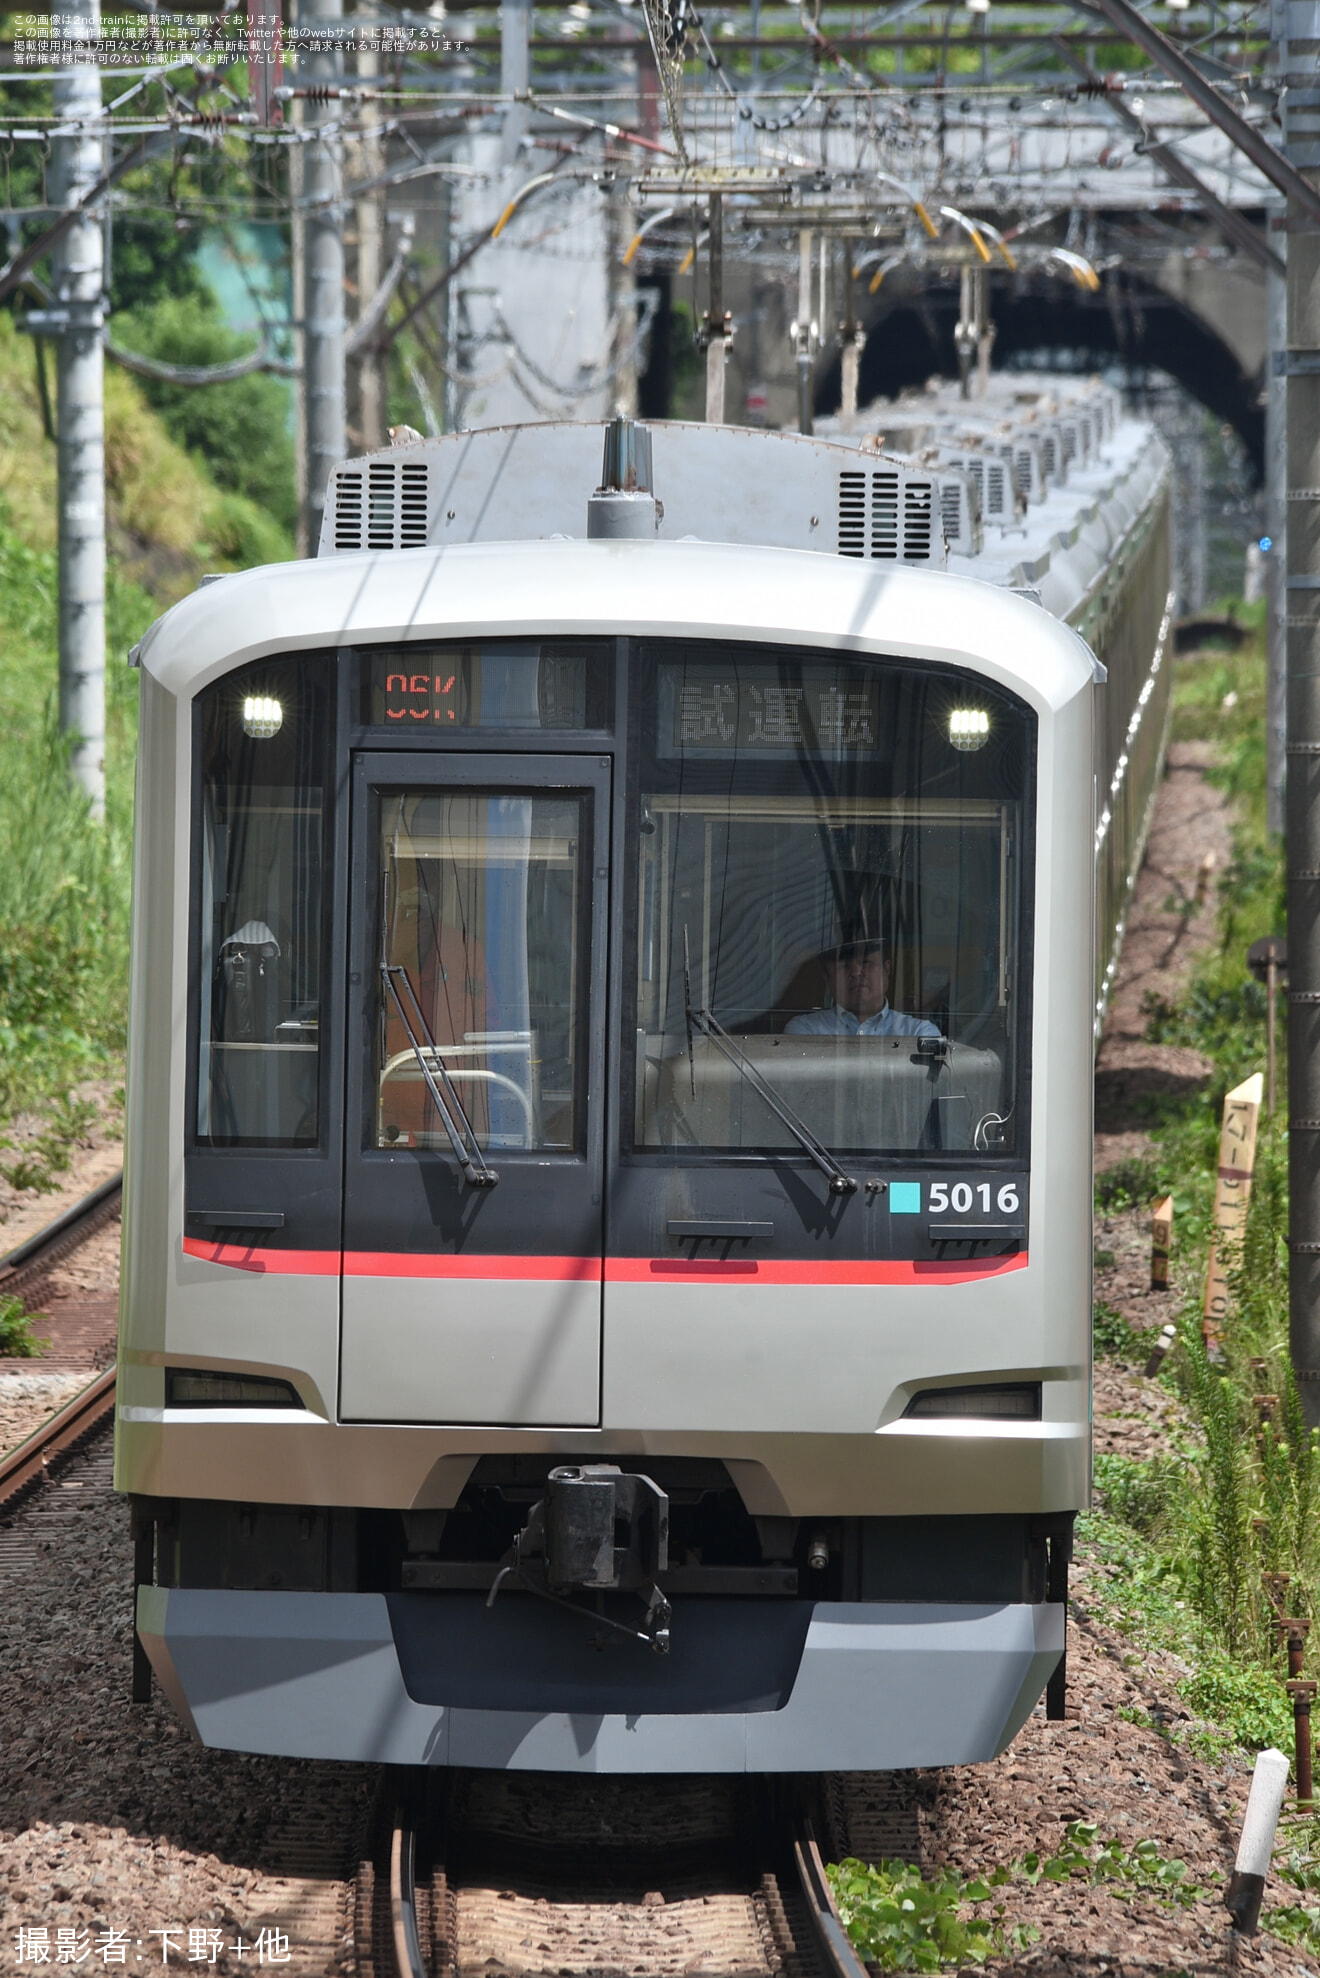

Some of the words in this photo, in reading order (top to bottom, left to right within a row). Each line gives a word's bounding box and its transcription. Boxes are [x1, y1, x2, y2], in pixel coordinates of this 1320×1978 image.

[679, 685, 874, 744] 試運転
[928, 1182, 1020, 1214] 5016
